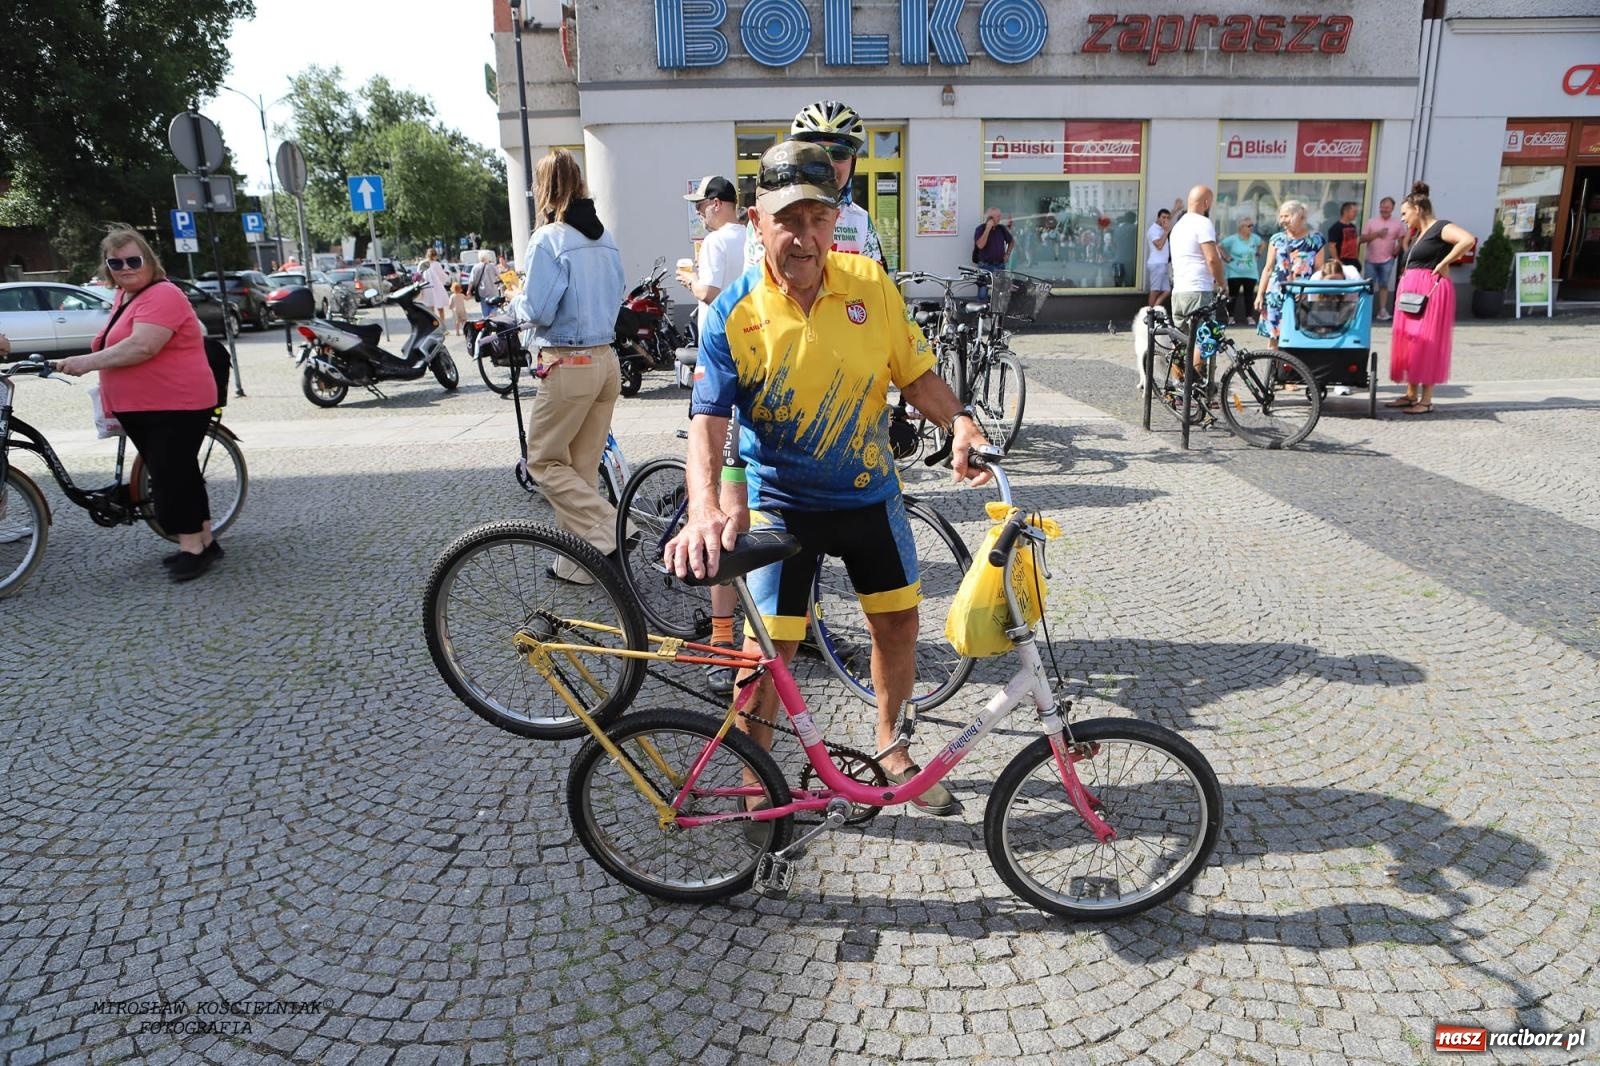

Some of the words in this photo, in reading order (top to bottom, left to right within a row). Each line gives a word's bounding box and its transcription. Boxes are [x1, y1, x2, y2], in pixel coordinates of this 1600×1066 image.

[655, 0, 1049, 69] BOLKO
[1081, 13, 1354, 66] zaprasza
[1011, 140, 1054, 154] Bliski
[1245, 139, 1287, 154] Bliski
[175, 211, 190, 230] P
[246, 215, 259, 230] P
[834, 226, 858, 234] ICTORIA
